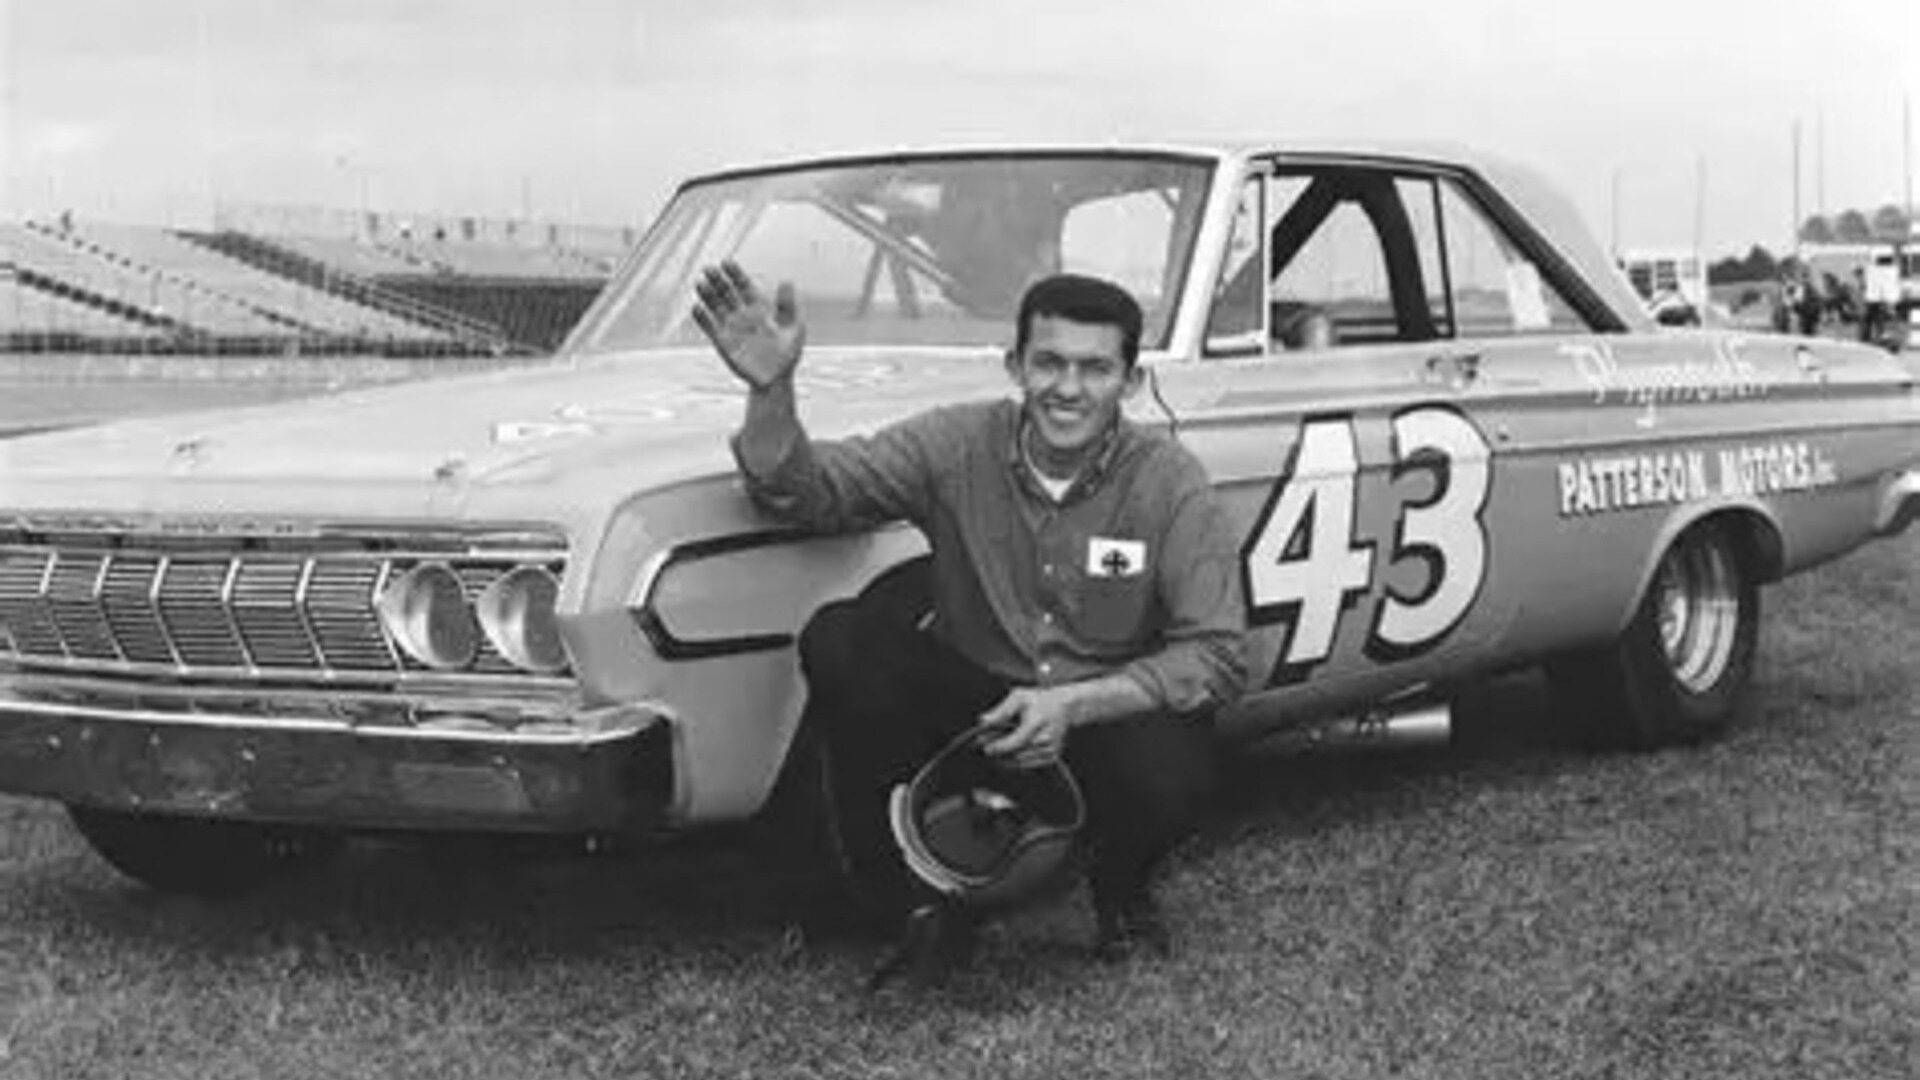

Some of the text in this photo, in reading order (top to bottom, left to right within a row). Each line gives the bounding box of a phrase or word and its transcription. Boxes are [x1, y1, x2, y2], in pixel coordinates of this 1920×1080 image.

[1243, 403, 1493, 678] 43
[1558, 450, 1706, 514] PATTERSON
[1718, 443, 1812, 499] MOTORS
